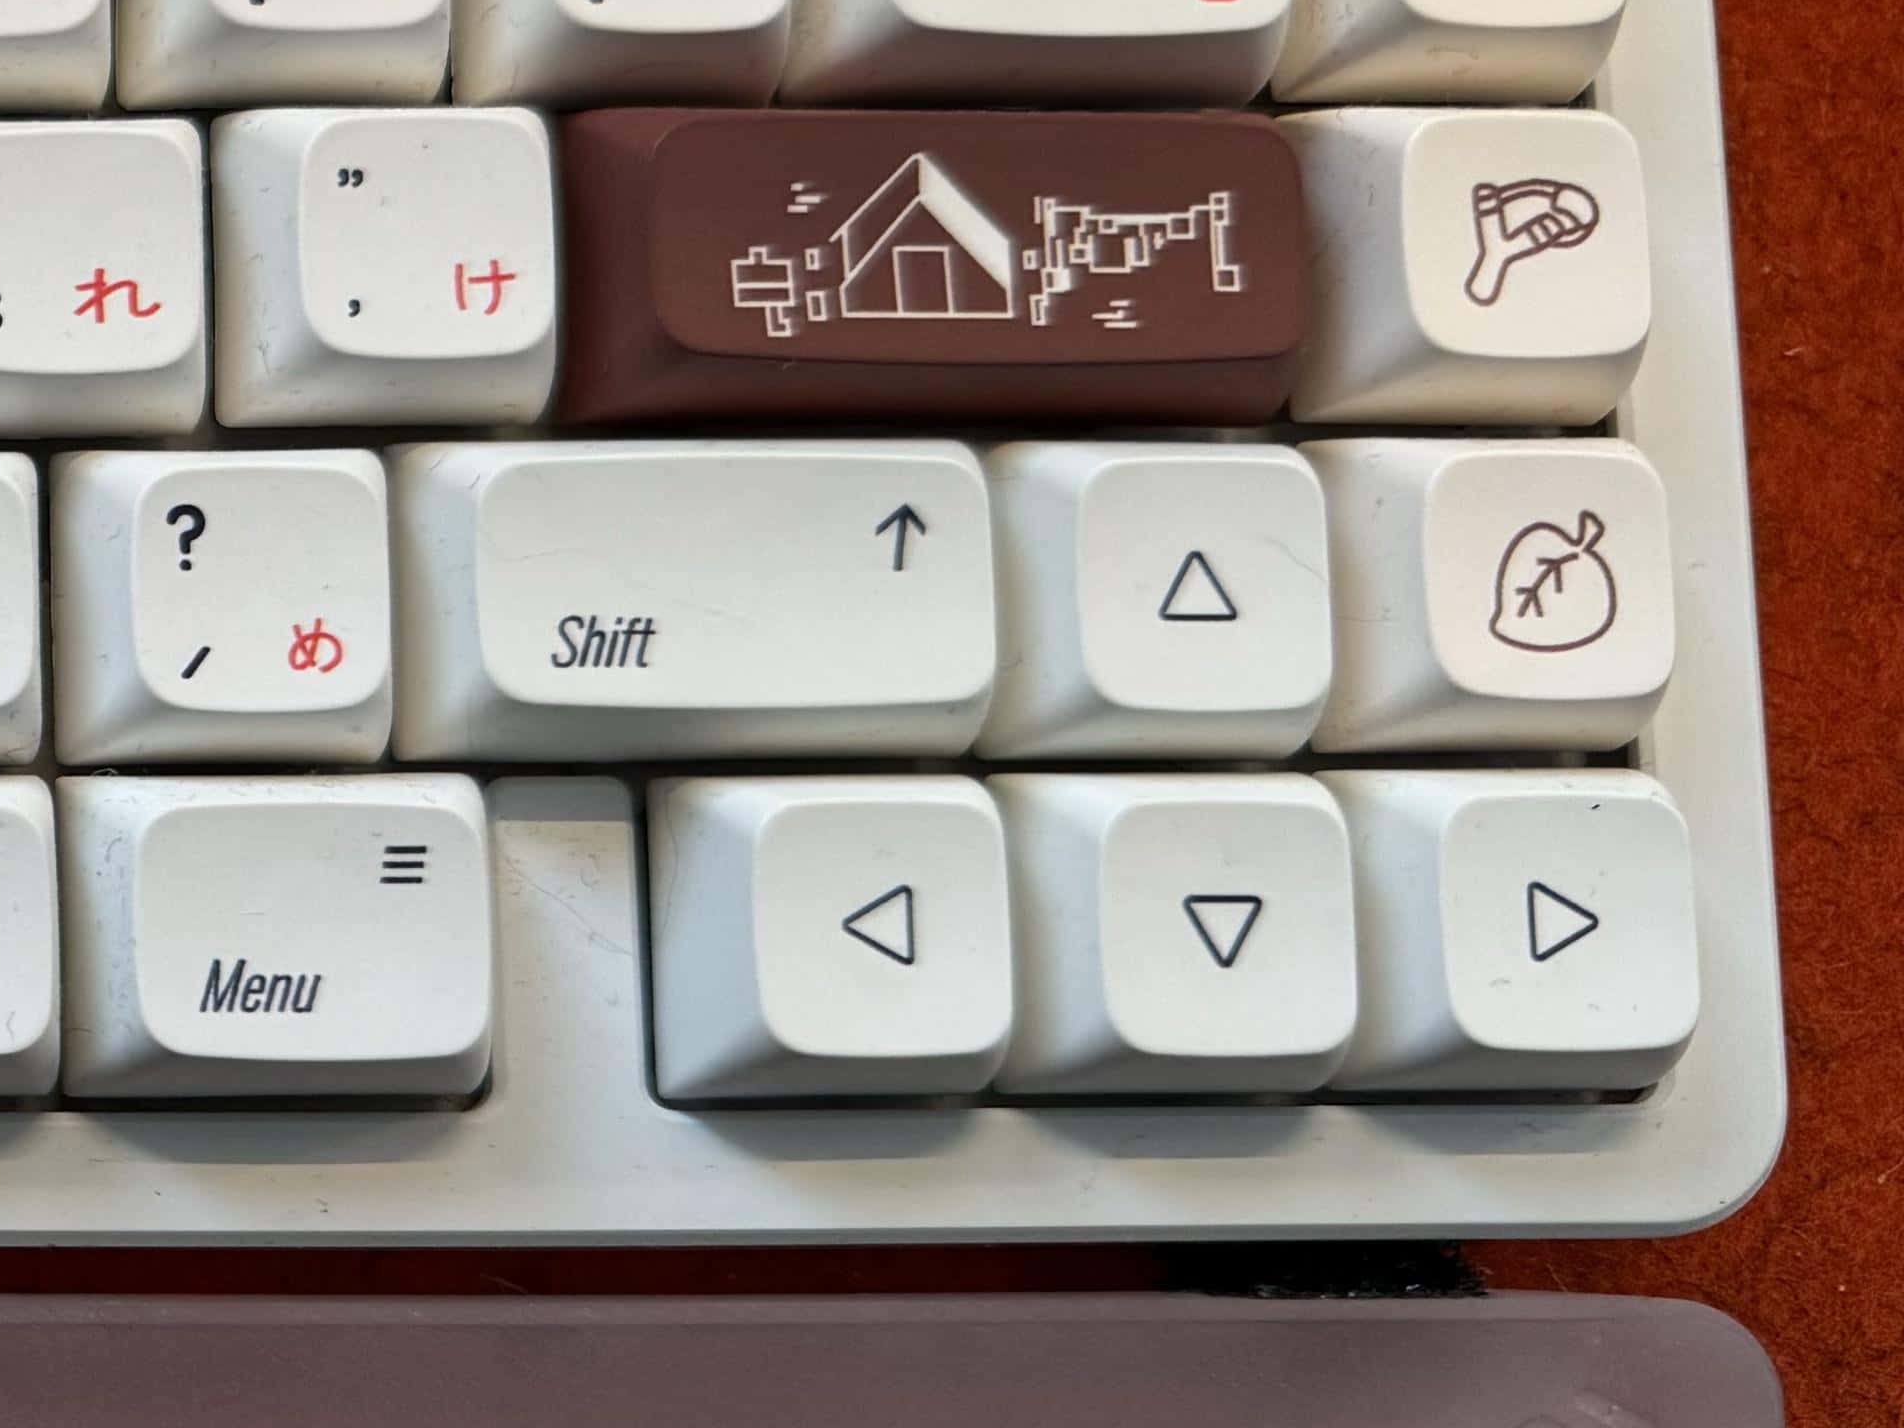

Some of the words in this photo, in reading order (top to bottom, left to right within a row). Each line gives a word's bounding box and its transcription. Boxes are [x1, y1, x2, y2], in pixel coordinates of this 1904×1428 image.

[74, 266, 162, 325] れ
[452, 258, 518, 317] け
[165, 502, 208, 573] ?
[180, 645, 213, 681] /
[286, 617, 346, 675] め
[550, 613, 658, 670] Shift
[198, 957, 323, 1015] Menu
